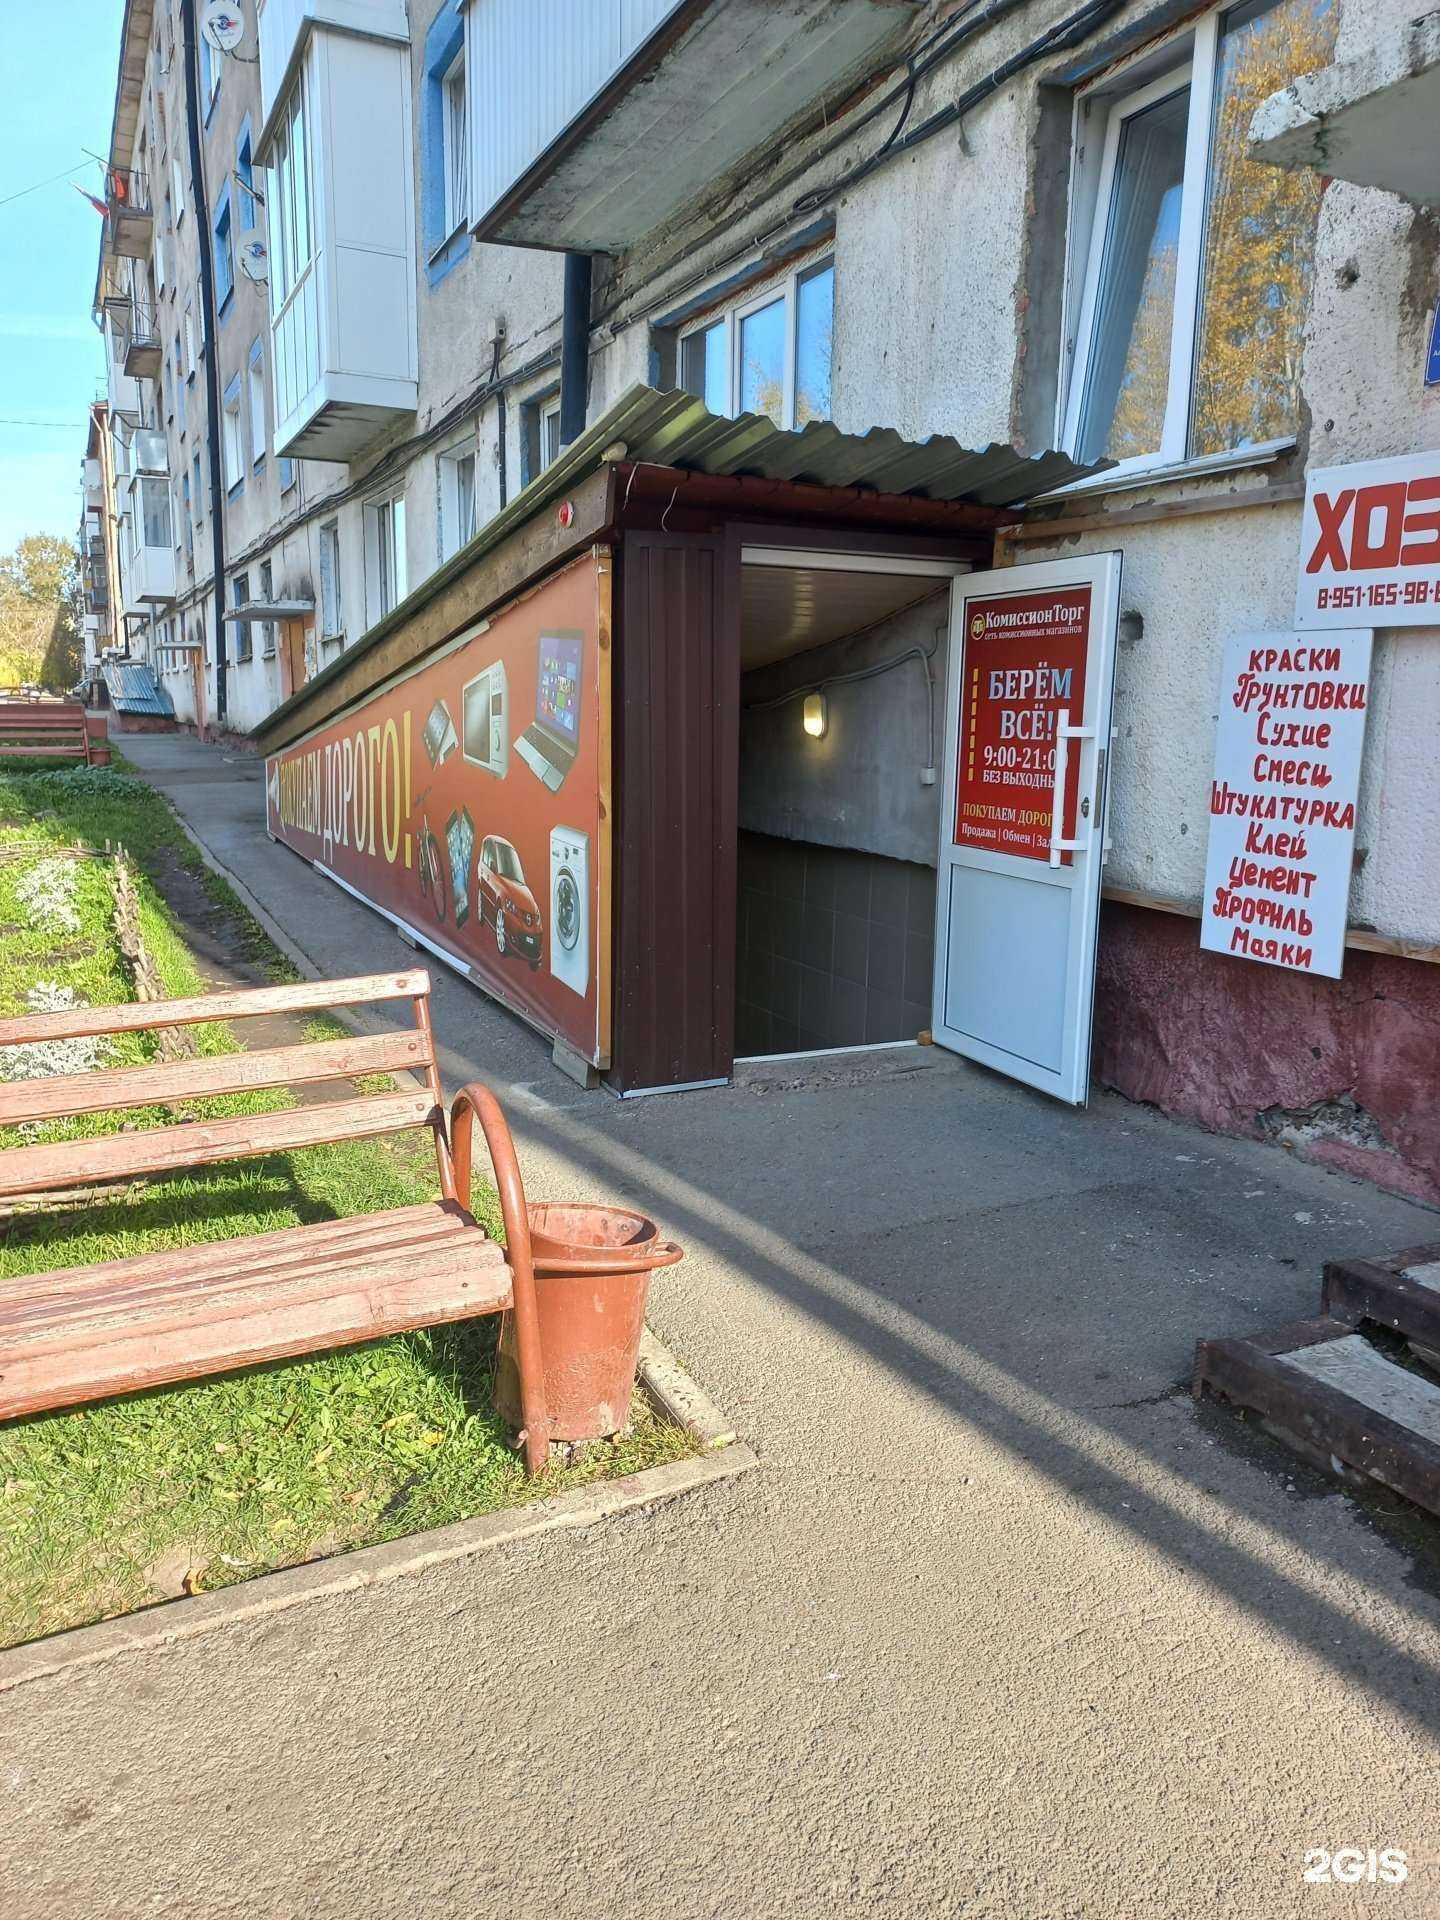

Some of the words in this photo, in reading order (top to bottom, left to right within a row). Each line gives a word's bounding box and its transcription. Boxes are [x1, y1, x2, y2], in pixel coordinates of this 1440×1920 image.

[985, 604, 1085, 630] КомиссионТорг
[1045, 625, 1083, 635] магазинов
[1249, 648, 1341, 672] КРАСКИ
[988, 661, 1073, 700] БЕРЁМ
[1000, 703, 1054, 741] ВСЁ!
[1257, 711, 1331, 748] Сухие
[983, 745, 1068, 771] 9:00-21:0
[323, 710, 412, 869] ДОРОГО!
[983, 770, 1001, 784] БЕЗ
[1002, 771, 1056, 789] ВЫХОДНЫ
[963, 803, 1016, 822] ПОКУПАЕМ
[1018, 810, 1053, 827] ДОРОГ
[962, 823, 996, 838] Продажа
[1002, 829, 1031, 844] Обмен
[1245, 821, 1307, 860] Клей
